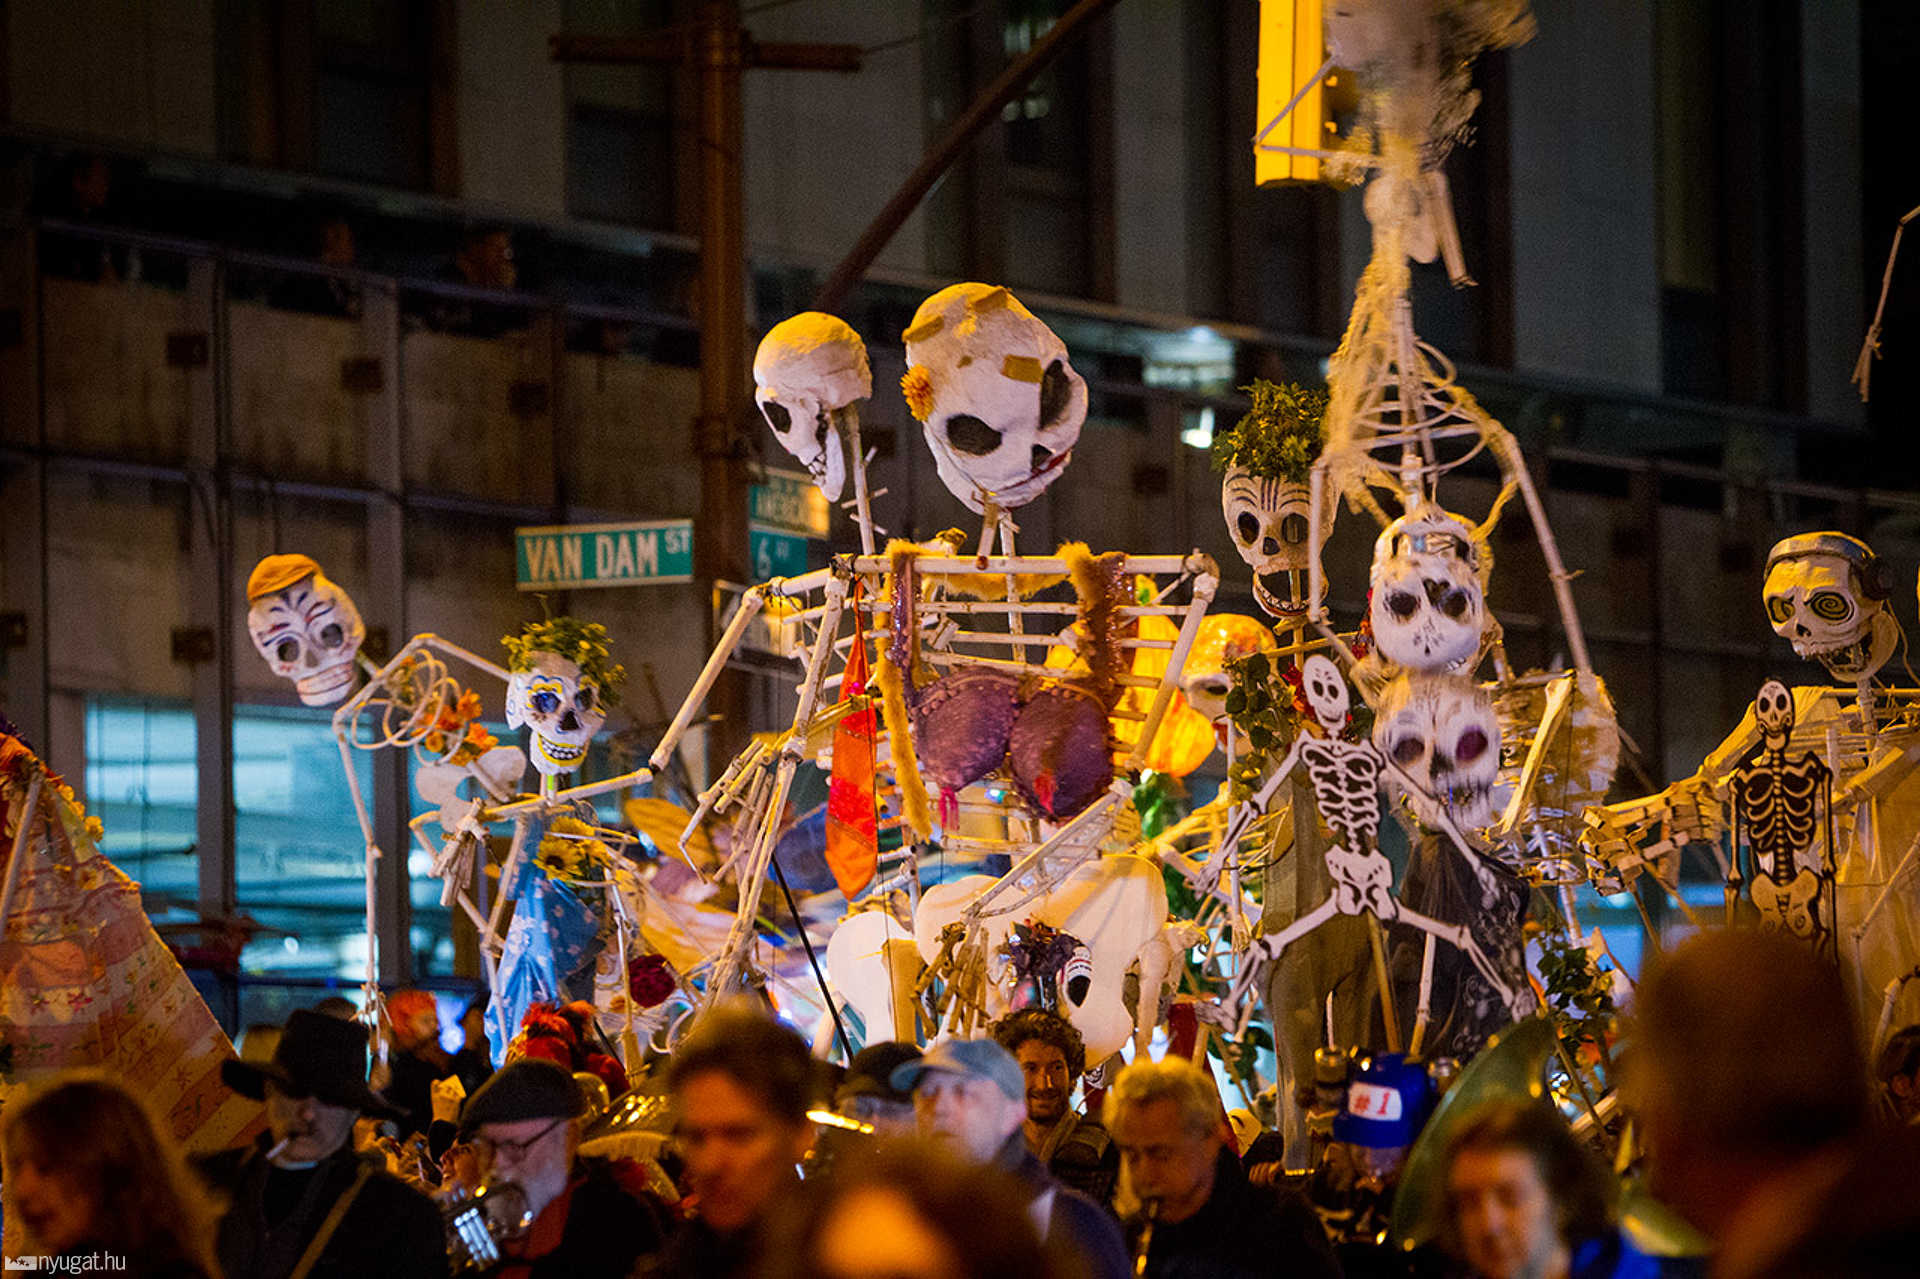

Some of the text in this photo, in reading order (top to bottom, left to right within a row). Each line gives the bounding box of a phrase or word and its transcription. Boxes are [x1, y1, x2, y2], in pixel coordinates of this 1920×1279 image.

[525, 527, 690, 580] VAN DAM ST
[757, 536, 771, 579] 6
